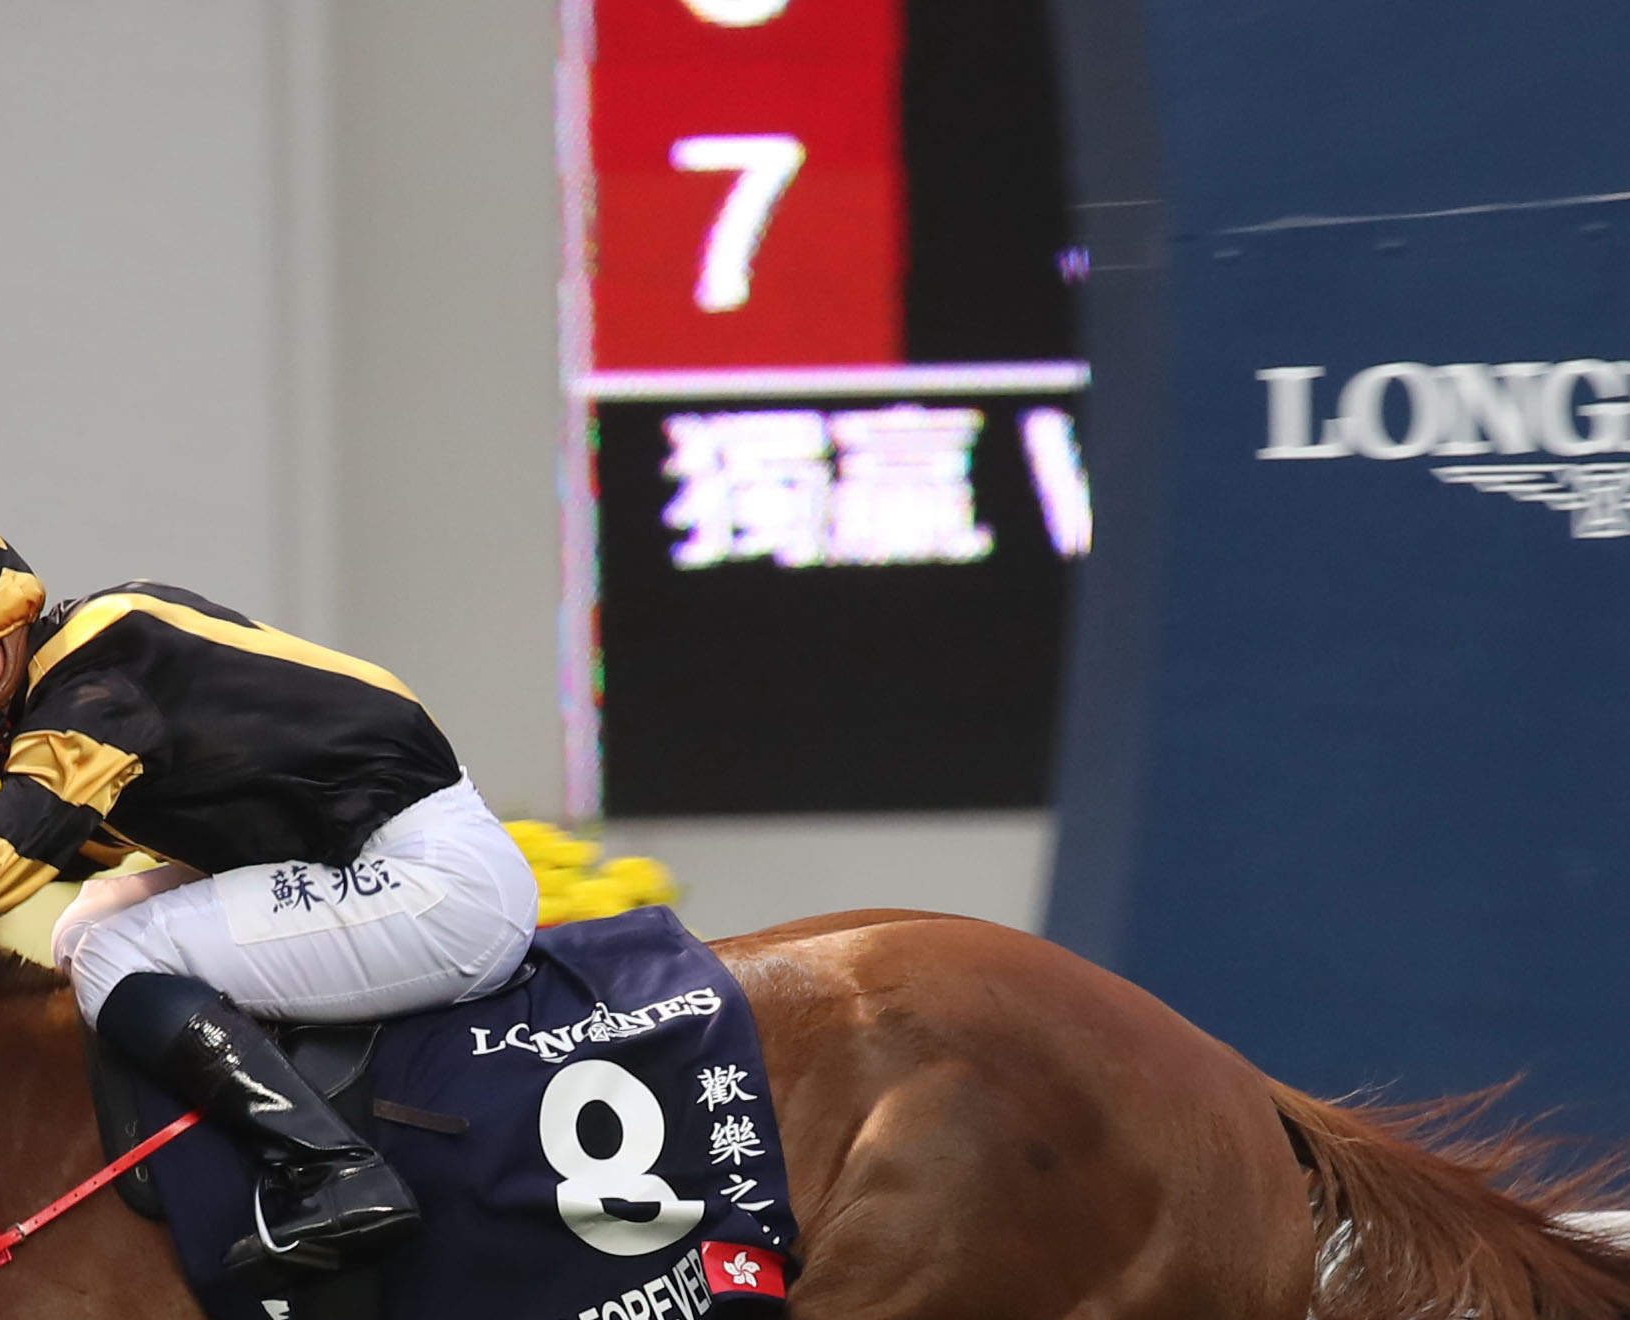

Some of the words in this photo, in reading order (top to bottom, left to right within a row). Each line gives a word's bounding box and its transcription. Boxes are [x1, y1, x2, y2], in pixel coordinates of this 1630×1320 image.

[669, 133, 807, 312] 7
[470, 987, 722, 1056] LONGNES
[539, 1059, 704, 1256] 8
[696, 1064, 781, 1246] 歡樂之
